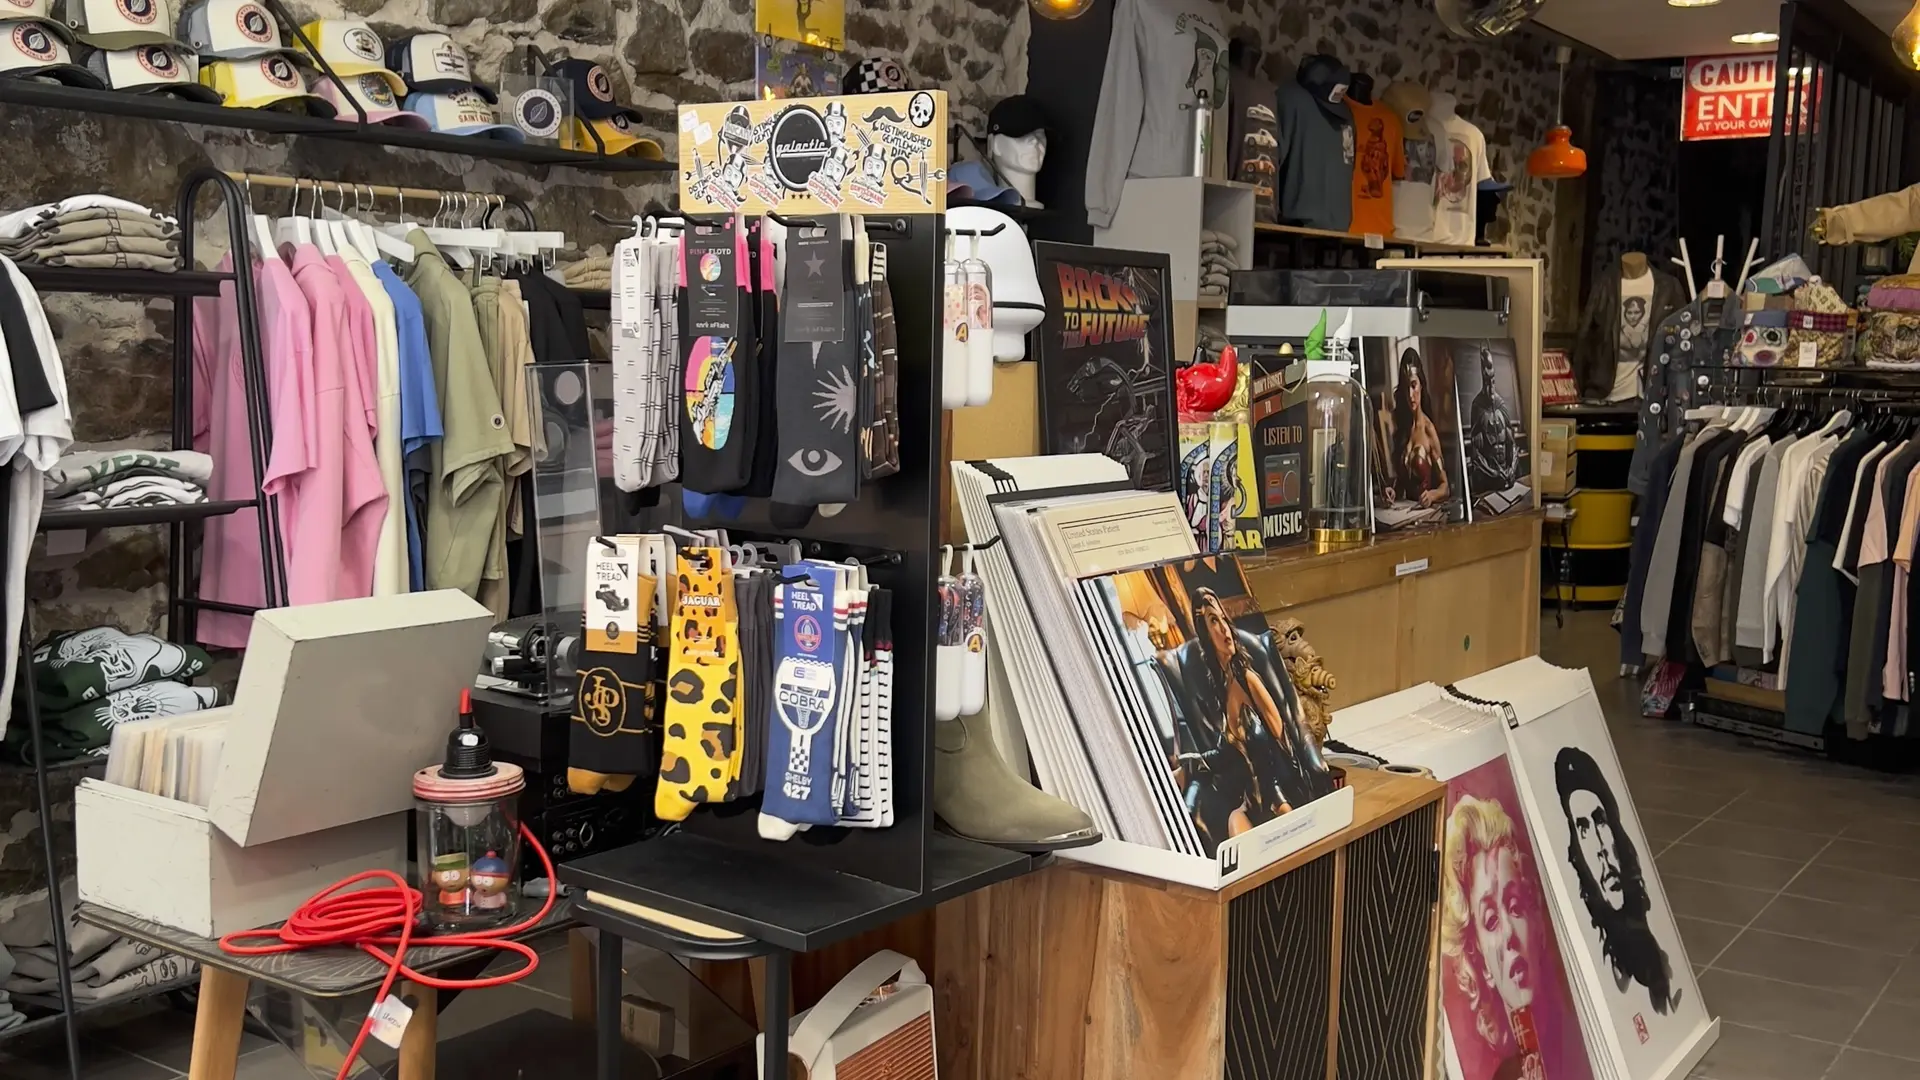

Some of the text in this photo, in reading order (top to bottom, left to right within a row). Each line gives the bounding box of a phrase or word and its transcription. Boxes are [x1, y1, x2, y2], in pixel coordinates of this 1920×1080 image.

[1696, 122, 1711, 132] AT
[1714, 120, 1746, 130] YOUR
[1749, 118, 1773, 129] OW
[880, 121, 932, 148] DISTINGUISHED
[776, 139, 826, 158] galactic
[1057, 263, 1133, 312] BACK
[1064, 312, 1079, 330] TO
[1080, 312, 1150, 346] FUTURE
[1264, 425, 1303, 446] LISTEN TO
[1102, 524, 1121, 534] Patent
[1263, 510, 1303, 539] MUSIC
[596, 562, 615, 571] HEEL
[596, 571, 622, 581] TREAD
[682, 595, 721, 606] JAGUAR
[791, 591, 810, 600] HEEL
[791, 600, 817, 611] TREAD
[778, 691, 826, 711] COBRA
[784, 772, 813, 785] SHELBY
[782, 782, 812, 800] 427
